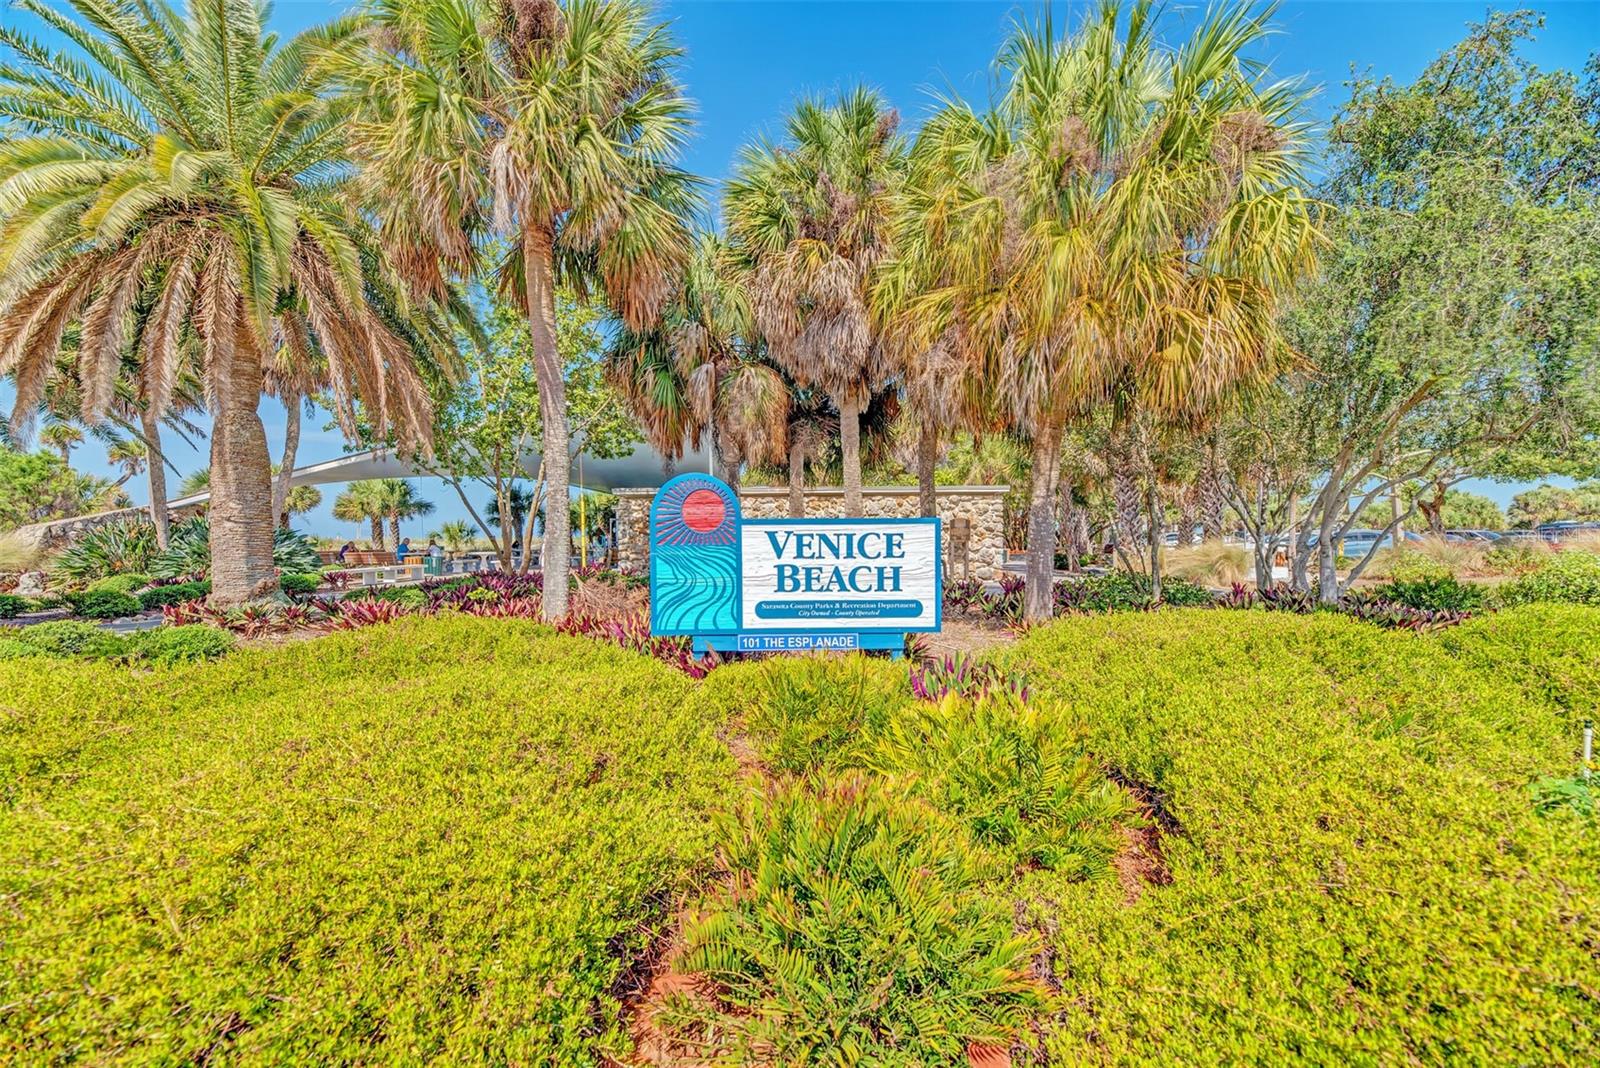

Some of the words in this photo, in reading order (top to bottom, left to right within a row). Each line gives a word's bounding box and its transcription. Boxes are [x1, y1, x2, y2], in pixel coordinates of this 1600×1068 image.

[764, 530, 905, 560] VENICE
[773, 564, 903, 593] BEACH
[790, 603, 813, 611] County
[834, 602, 841, 610] &
[877, 602, 916, 610] Department
[798, 610, 811, 618] City
[834, 609, 855, 618] County
[855, 609, 880, 617] Operated
[742, 638, 760, 648] 101
[764, 638, 785, 647] THE
[787, 636, 854, 647] ESPLANADE
